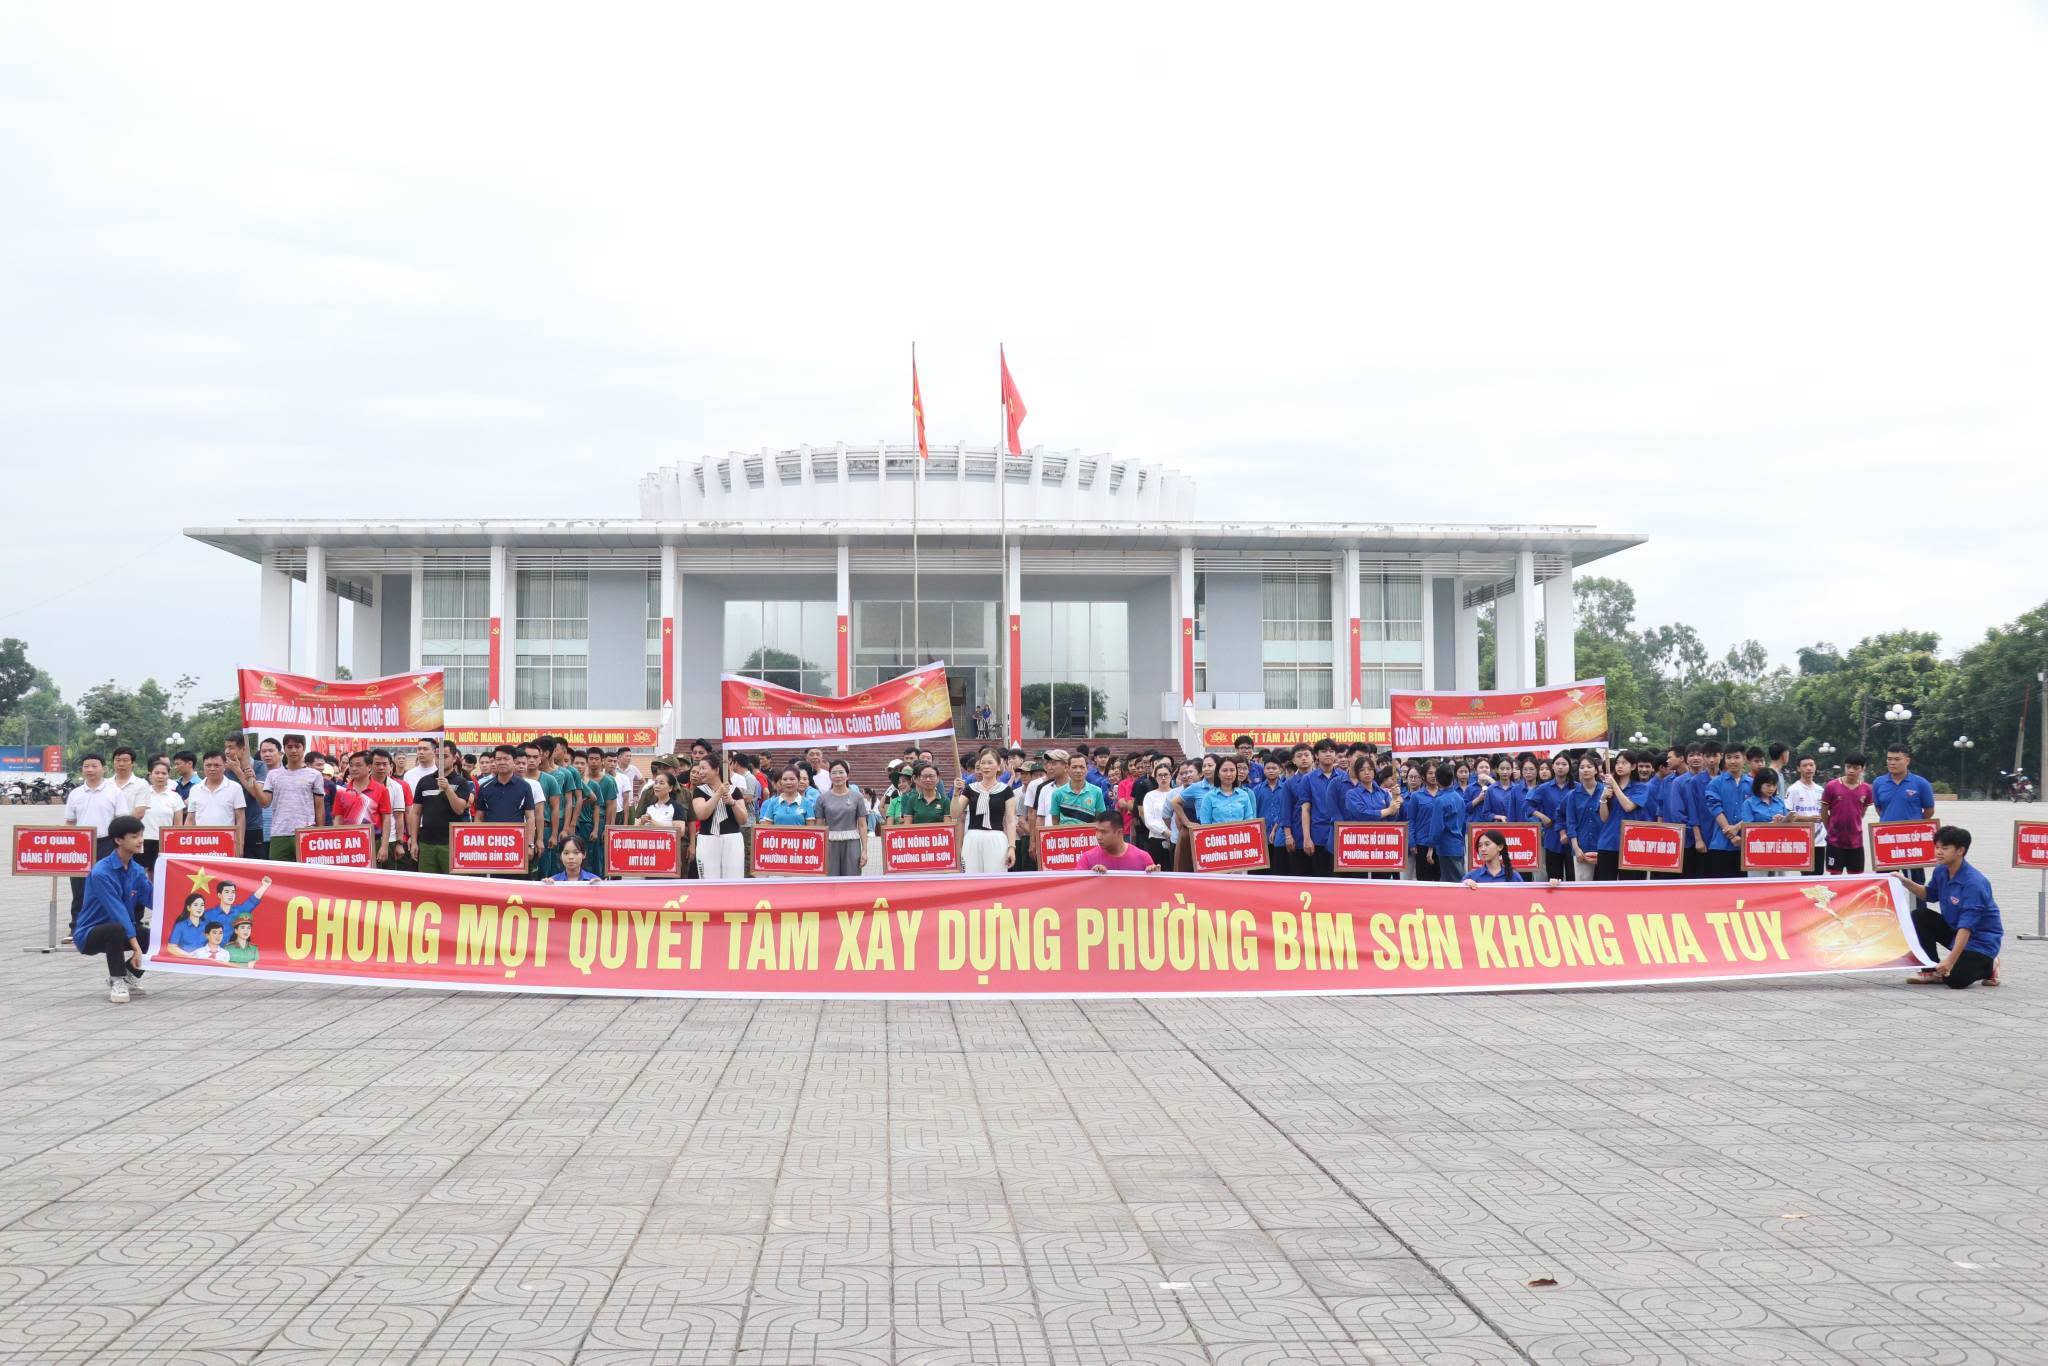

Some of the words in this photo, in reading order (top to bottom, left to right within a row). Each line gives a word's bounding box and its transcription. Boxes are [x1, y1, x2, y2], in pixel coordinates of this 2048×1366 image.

[251, 700, 276, 721] THOÁT
[277, 700, 297, 722] KHỎI
[298, 706, 311, 723] MA
[314, 703, 329, 727] TÚY,
[330, 704, 346, 725] LÀM
[348, 707, 360, 730] LẠI
[362, 704, 383, 730] CUỘC
[385, 703, 399, 726] ĐỜI
[725, 717, 741, 736] MA
[743, 713, 760, 736] TÚY
[762, 713, 775, 735] LÀ
[776, 710, 800, 735] HIỂM
[803, 718, 823, 738] HỌA
[825, 713, 844, 733] CỦA
[846, 714, 872, 733] CÔNG
[874, 706, 901, 731] ĐỒNG
[459, 730, 479, 742] NƯỚC
[480, 732, 504, 745] MẠNH,
[507, 730, 522, 743] DÂN
[588, 730, 603, 743] VĂN
[605, 733, 624, 743] MINH
[1261, 731, 1281, 743] TÂM
[1283, 731, 1301, 743] XÂY
[1330, 729, 1365, 743] PHƯỜNG
[1394, 723, 1420, 746] TOÀN
[1423, 723, 1443, 744] DÂN
[1446, 722, 1463, 744] NÓI
[1465, 720, 1500, 743] KHÔNG
[1502, 719, 1519, 741] VỚI
[1521, 722, 1538, 740] MA
[1540, 716, 1558, 739] TÚY
[34, 834, 48, 845] CƠ
[50, 836, 75, 846] QUAN
[179, 836, 193, 846] CƠ
[194, 836, 219, 846] QUAN
[309, 836, 341, 851] CÔNG
[344, 837, 362, 849] AN
[463, 835, 485, 847] BAN
[486, 835, 515, 847] CHQS
[763, 837, 778, 851] HỘI
[781, 839, 799, 852] PHỤ
[802, 837, 816, 850] NỮ
[892, 836, 906, 850] HỘI
[907, 834, 930, 848] NÔNG
[932, 833, 949, 847] DÂN
[1046, 836, 1057, 851] HỘI
[1070, 832, 1089, 848] CHIẾN
[1205, 834, 1227, 848] CÔNG
[1228, 831, 1251, 846] ĐOÀN
[1505, 837, 1522, 846] UAN,
[21, 851, 43, 864] ĐẢNG
[44, 850, 56, 864] ỦY
[56, 851, 88, 865] PHƯỜNG
[306, 854, 335, 865] PHƯỜNG
[351, 853, 366, 864] SƠN
[459, 850, 488, 861] PHƯỜNG
[489, 849, 503, 861] BỈM
[504, 850, 519, 861] SƠN
[760, 853, 788, 865] PHƯỜNG
[789, 852, 803, 865] BỈM
[804, 854, 819, 865] SƠN
[891, 852, 920, 864] PHƯỜNG
[921, 850, 935, 863] BỈM
[936, 850, 951, 862] SƠN
[1046, 852, 1075, 865] PHƯỜNG
[1201, 850, 1228, 863] PHƯỜNG
[1229, 847, 1243, 860] BỈM
[1244, 847, 1259, 859] SƠN
[1343, 848, 1370, 860] PHƯỜNG
[1371, 848, 1384, 860] BỈM
[1385, 850, 1399, 860] SƠN
[1906, 847, 1923, 858] SƠN
[284, 895, 442, 965] CHUNG
[455, 894, 556, 978] MỘT
[568, 894, 710, 975] QUYẾT
[723, 899, 820, 971] TÂM
[834, 897, 924, 971] XÂY
[938, 902, 1061, 985] DỰNG
[1076, 893, 1260, 971] PHƯỜNG
[1271, 891, 1359, 971] BỈM
[1370, 908, 1463, 970] SƠN
[1469, 902, 1625, 969] KHÔNG
[1627, 912, 1708, 965] MA
[1704, 899, 1791, 963] TÚY
